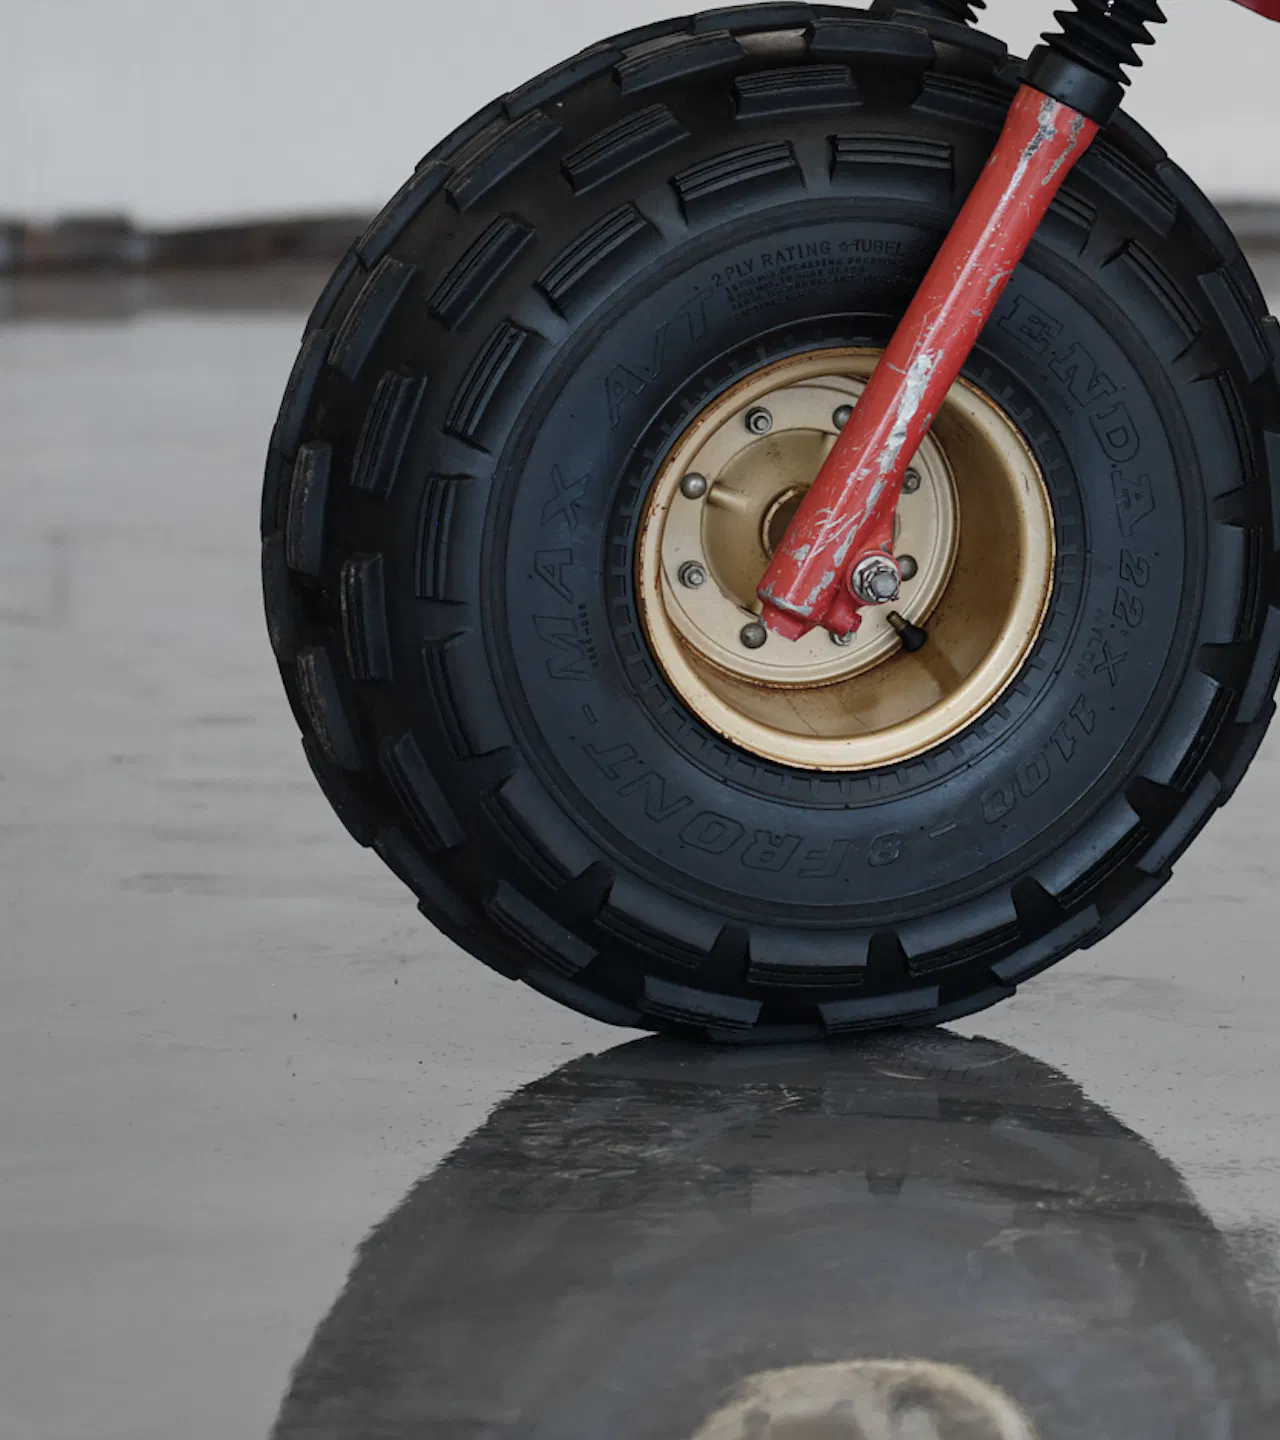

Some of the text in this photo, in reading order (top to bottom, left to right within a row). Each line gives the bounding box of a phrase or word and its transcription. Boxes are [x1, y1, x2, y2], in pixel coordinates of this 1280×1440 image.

[711, 273, 722, 287] 2
[725, 260, 754, 281] PLY
[761, 240, 831, 269] RATING
[996, 294, 1155, 537] ENDA
[532, 463, 592, 682] MAX
[581, 742, 853, 879] FRONT
